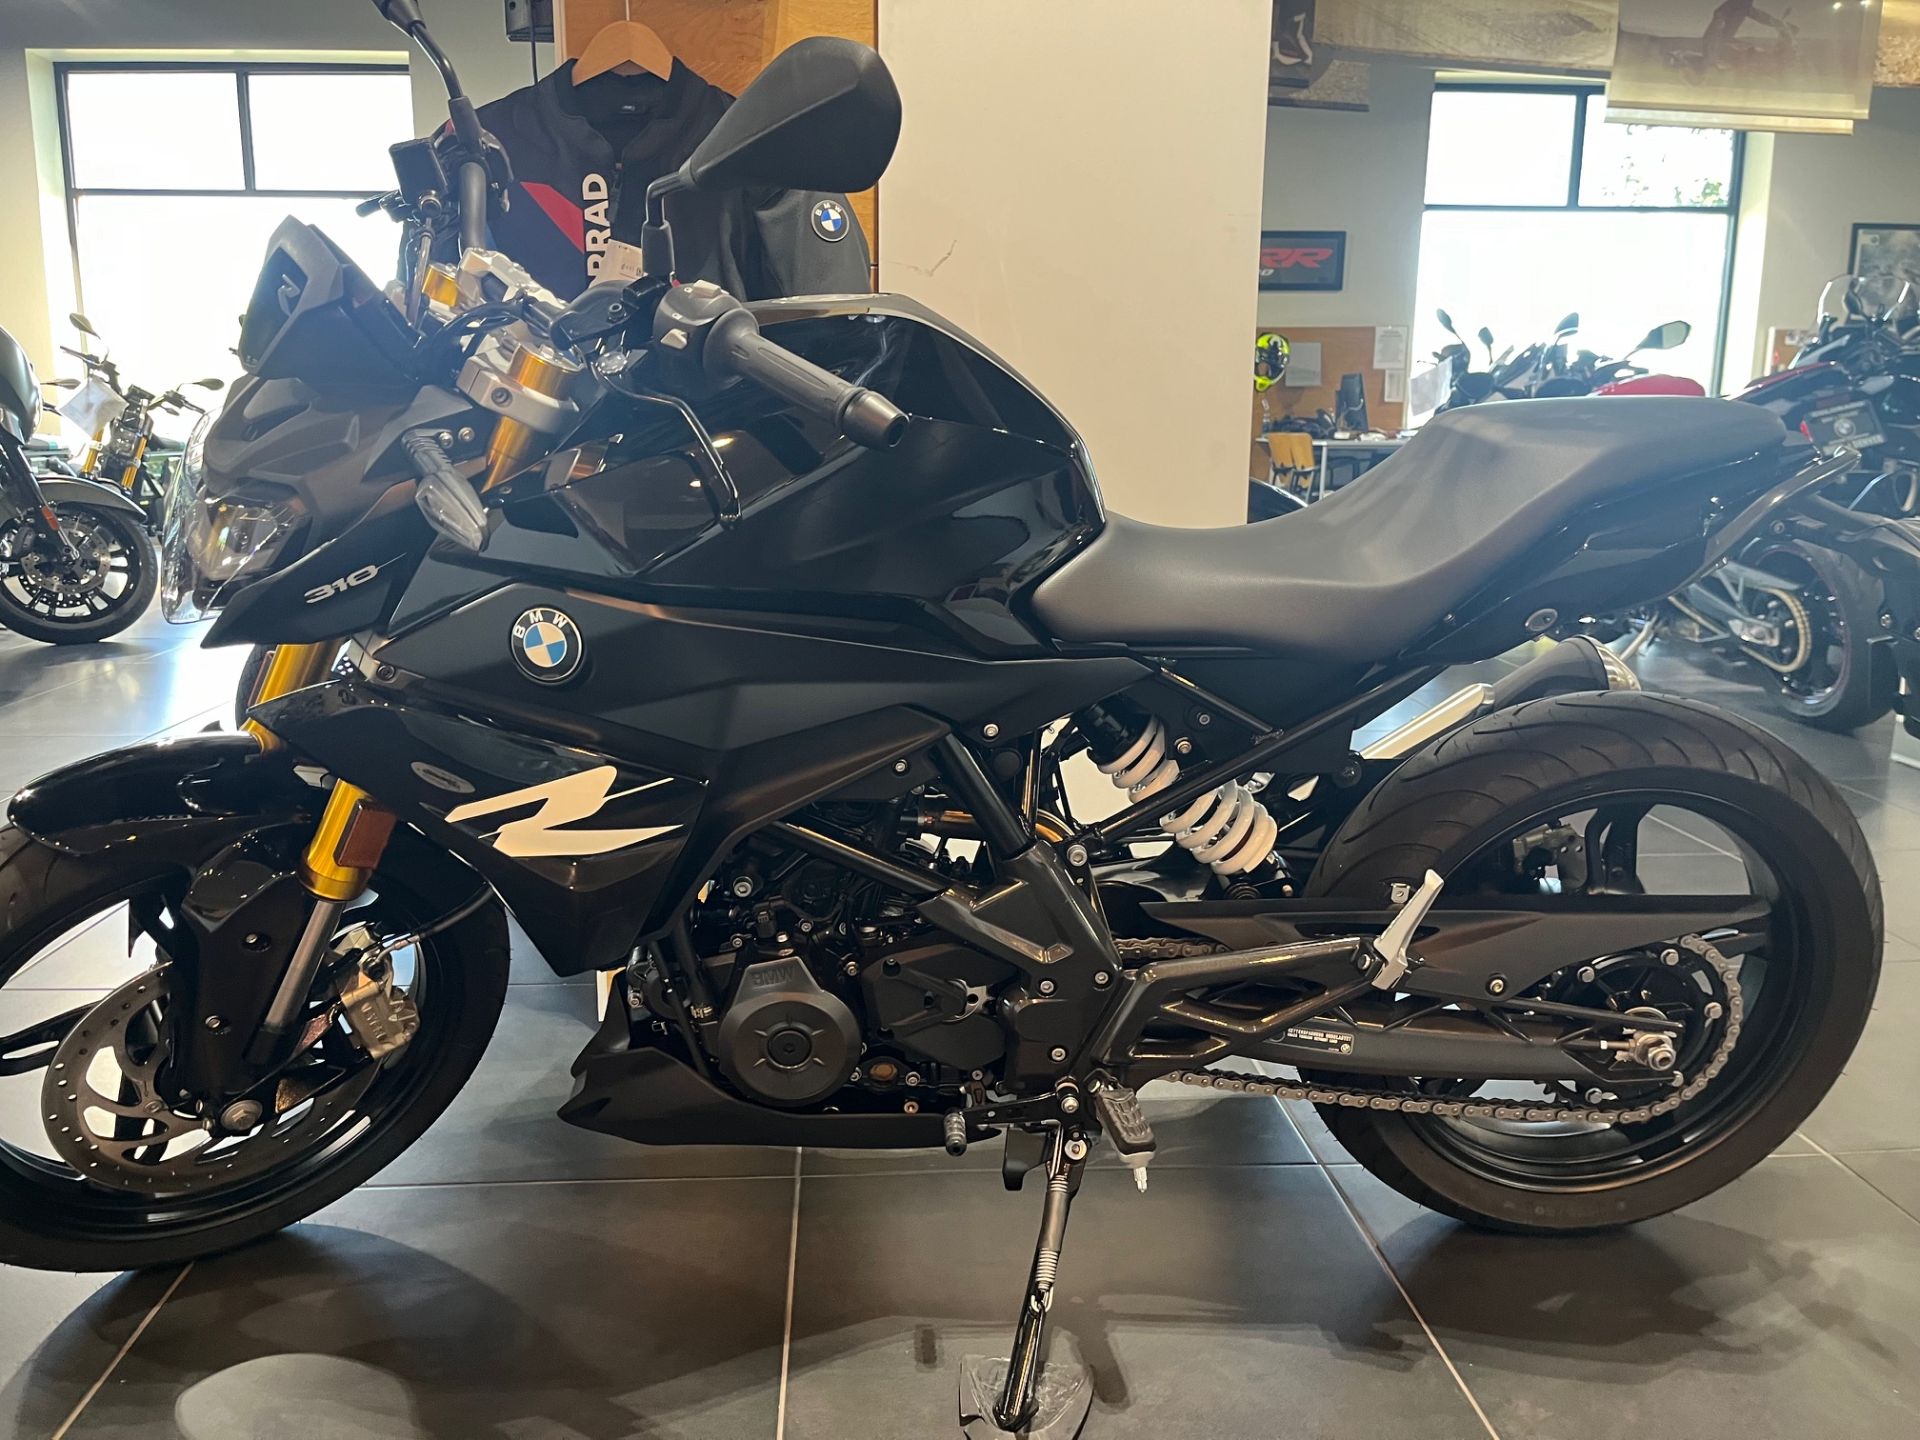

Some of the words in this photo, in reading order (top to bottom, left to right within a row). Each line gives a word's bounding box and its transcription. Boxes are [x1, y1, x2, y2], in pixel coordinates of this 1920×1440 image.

[815, 202, 842, 217] BMW
[304, 565, 378, 604] 310
[512, 609, 568, 639] BMW
